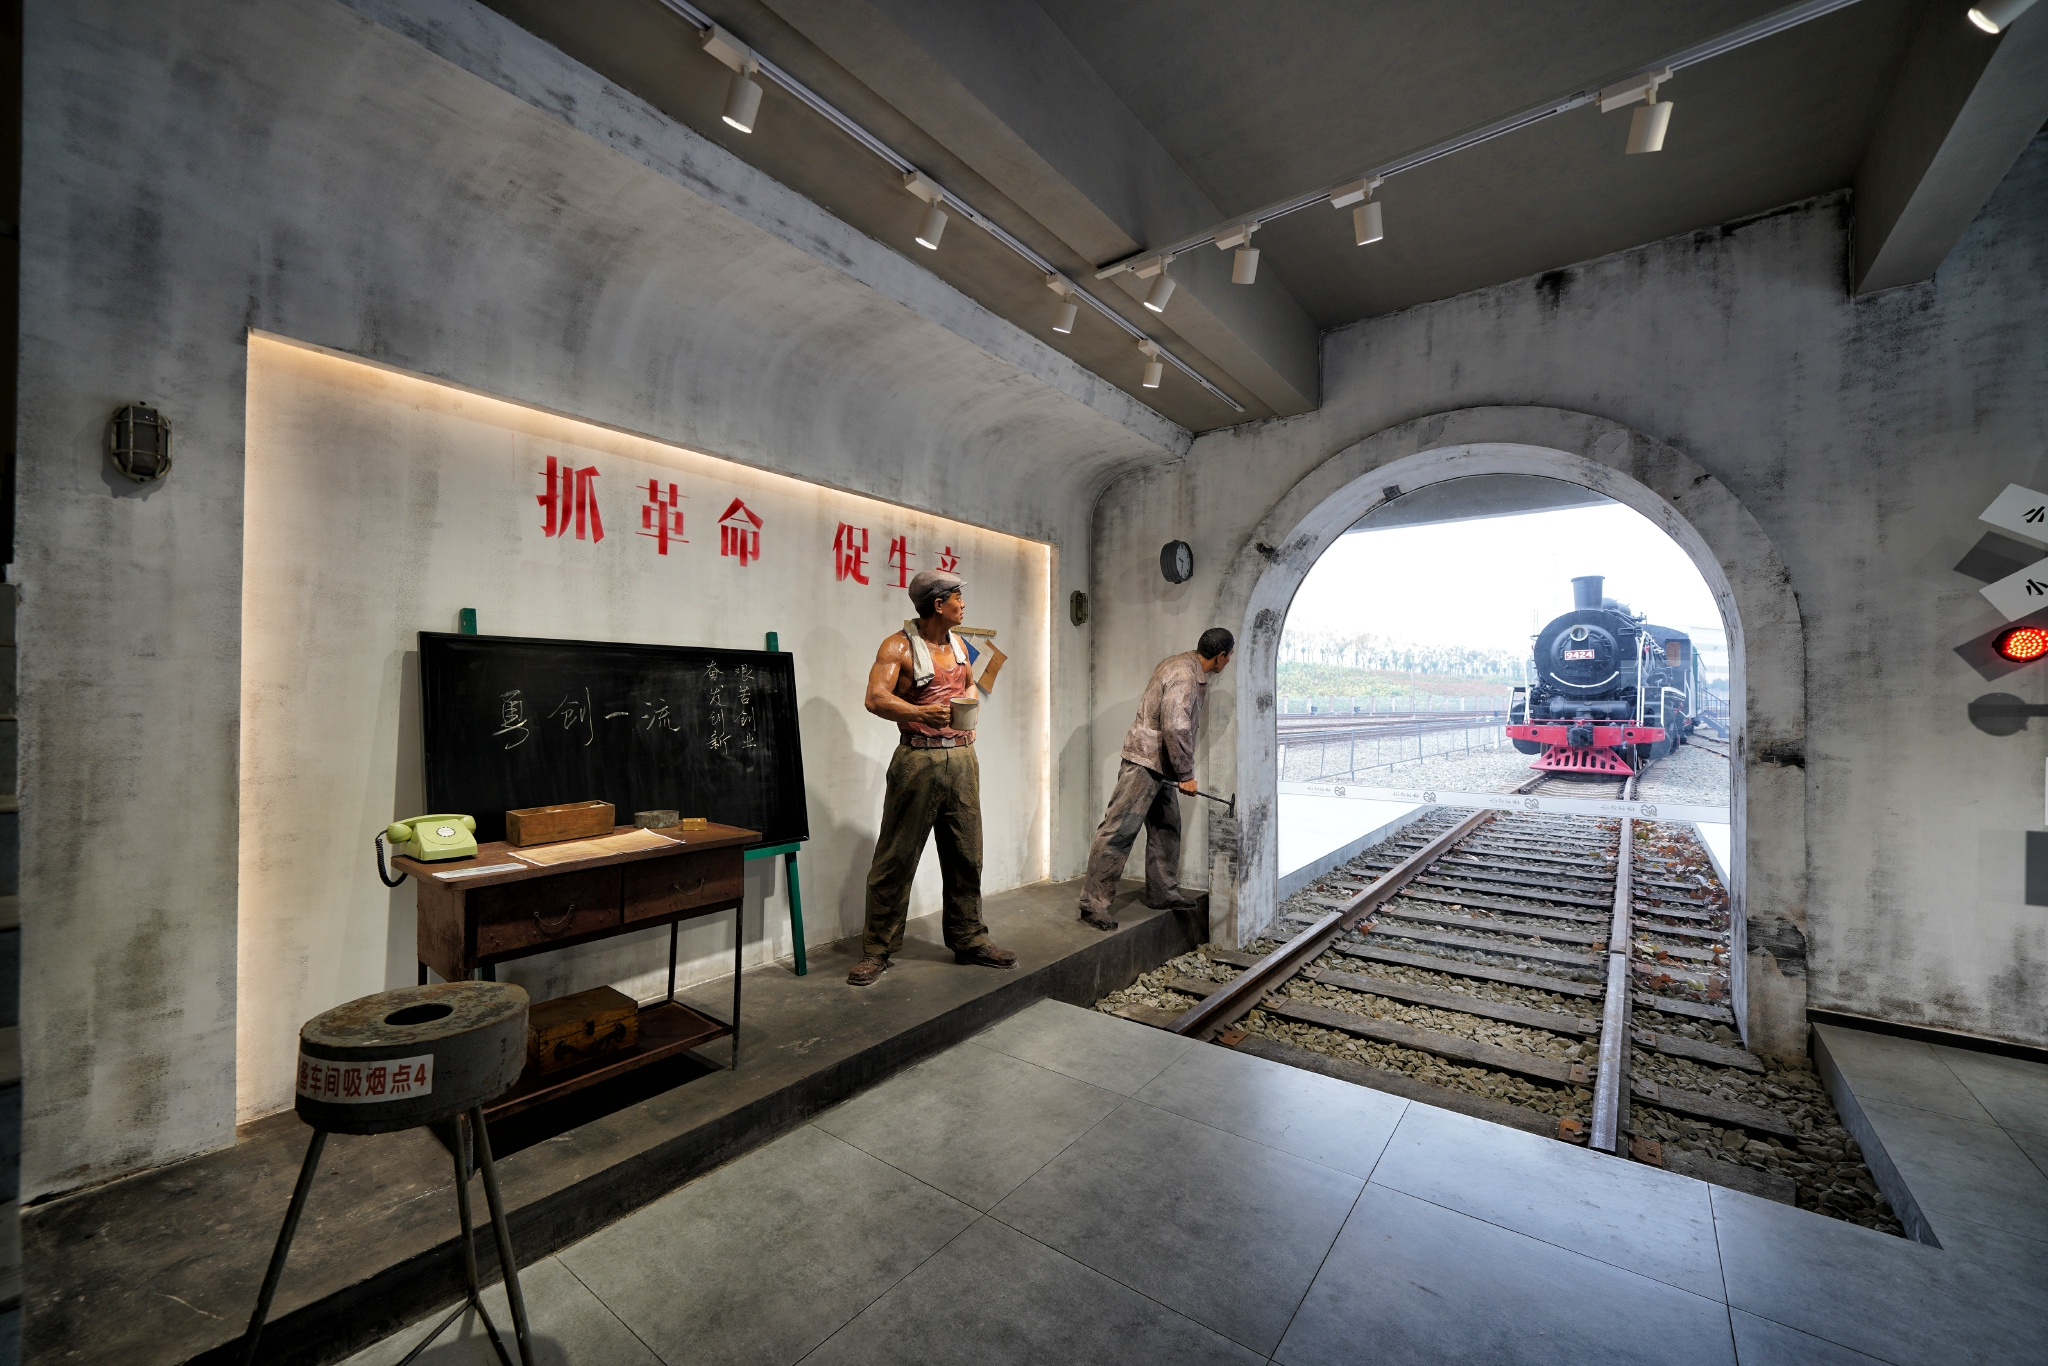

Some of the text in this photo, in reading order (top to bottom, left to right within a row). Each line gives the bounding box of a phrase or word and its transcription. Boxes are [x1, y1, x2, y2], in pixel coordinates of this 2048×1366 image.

[536, 455, 764, 567] 抓革命
[2021, 506, 2048, 523] 小
[1566, 651, 1593, 659] 9424
[492, 687, 681, 750] 勇创一流
[703, 660, 731, 755] 奋发创新
[733, 663, 757, 749] 艰苦创业
[297, 1058, 427, 1097] 备车间吸烟点4
